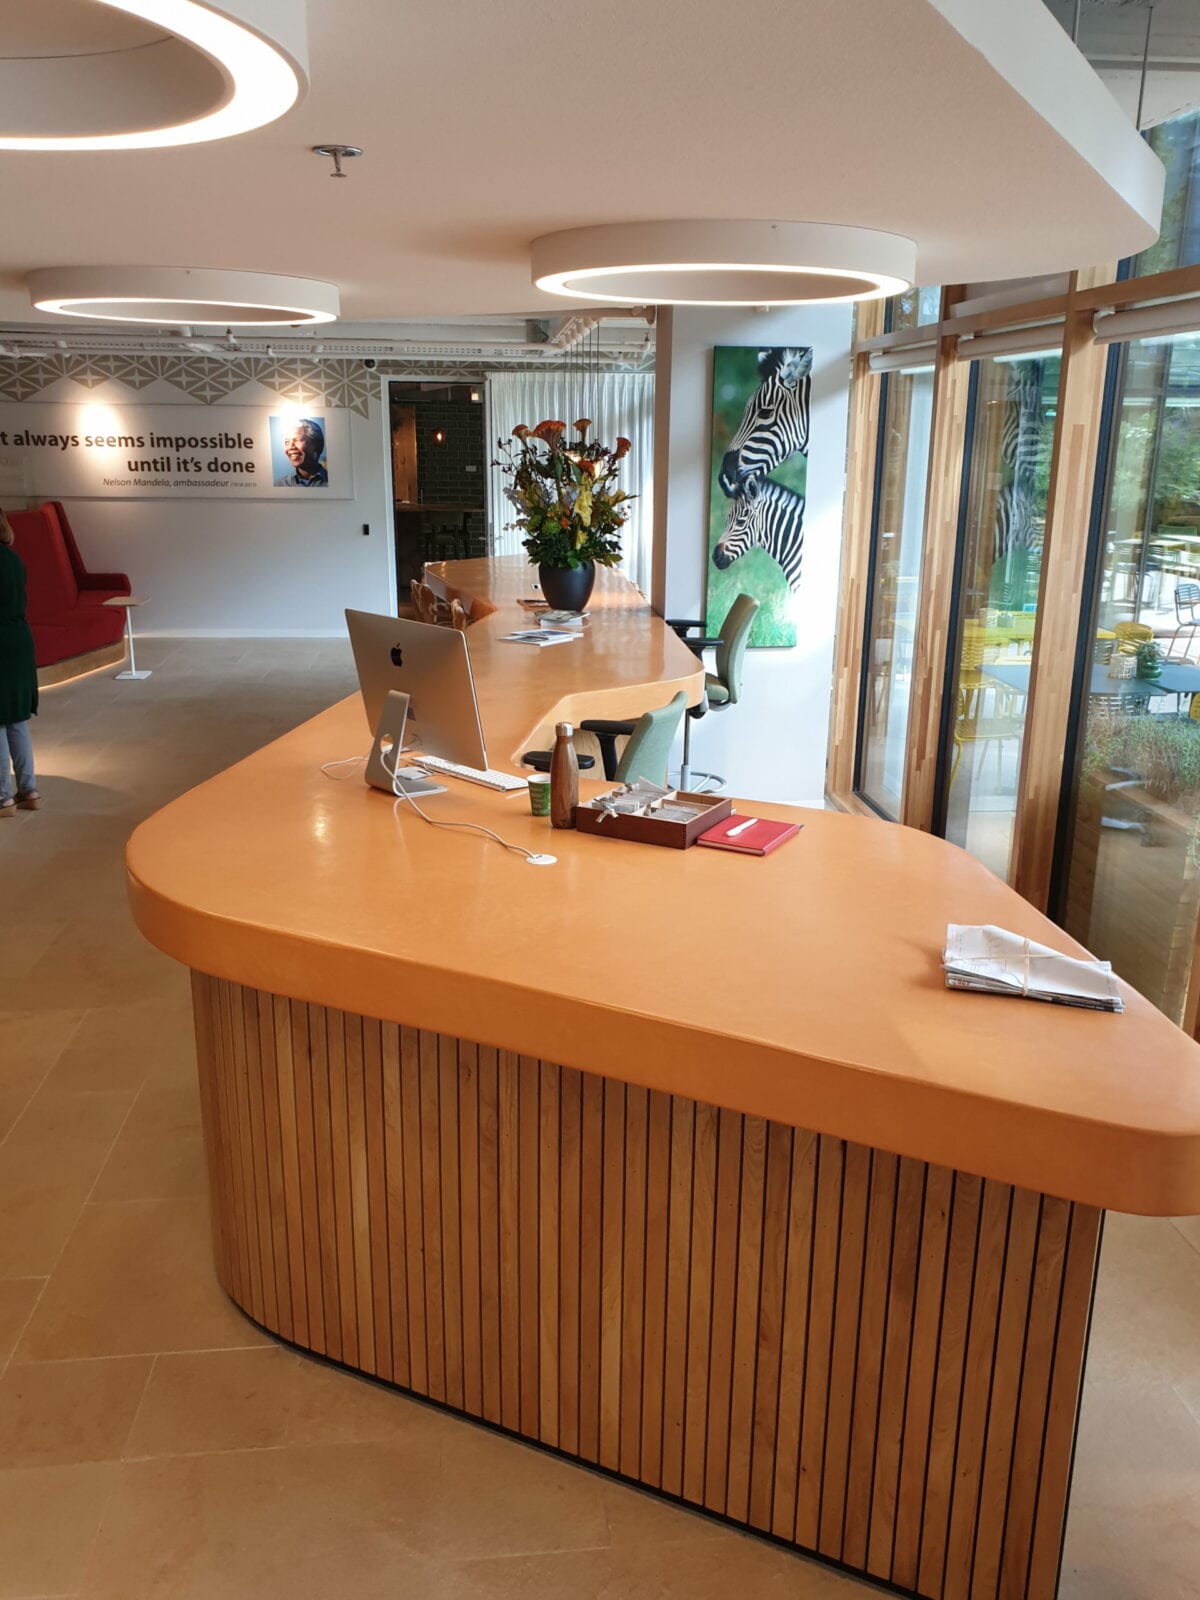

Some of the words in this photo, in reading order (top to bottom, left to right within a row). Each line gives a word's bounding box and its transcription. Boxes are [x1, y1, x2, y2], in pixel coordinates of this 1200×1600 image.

[13, 430, 79, 451] always
[85, 435, 145, 447] seems
[150, 432, 254, 452] impossible
[128, 456, 171, 472] until
[177, 457, 202, 472] it’s
[207, 457, 255, 473] done
[103, 478, 131, 486] Nelson
[133, 479, 171, 487] Mandela,
[173, 479, 229, 487] ambassadeur
